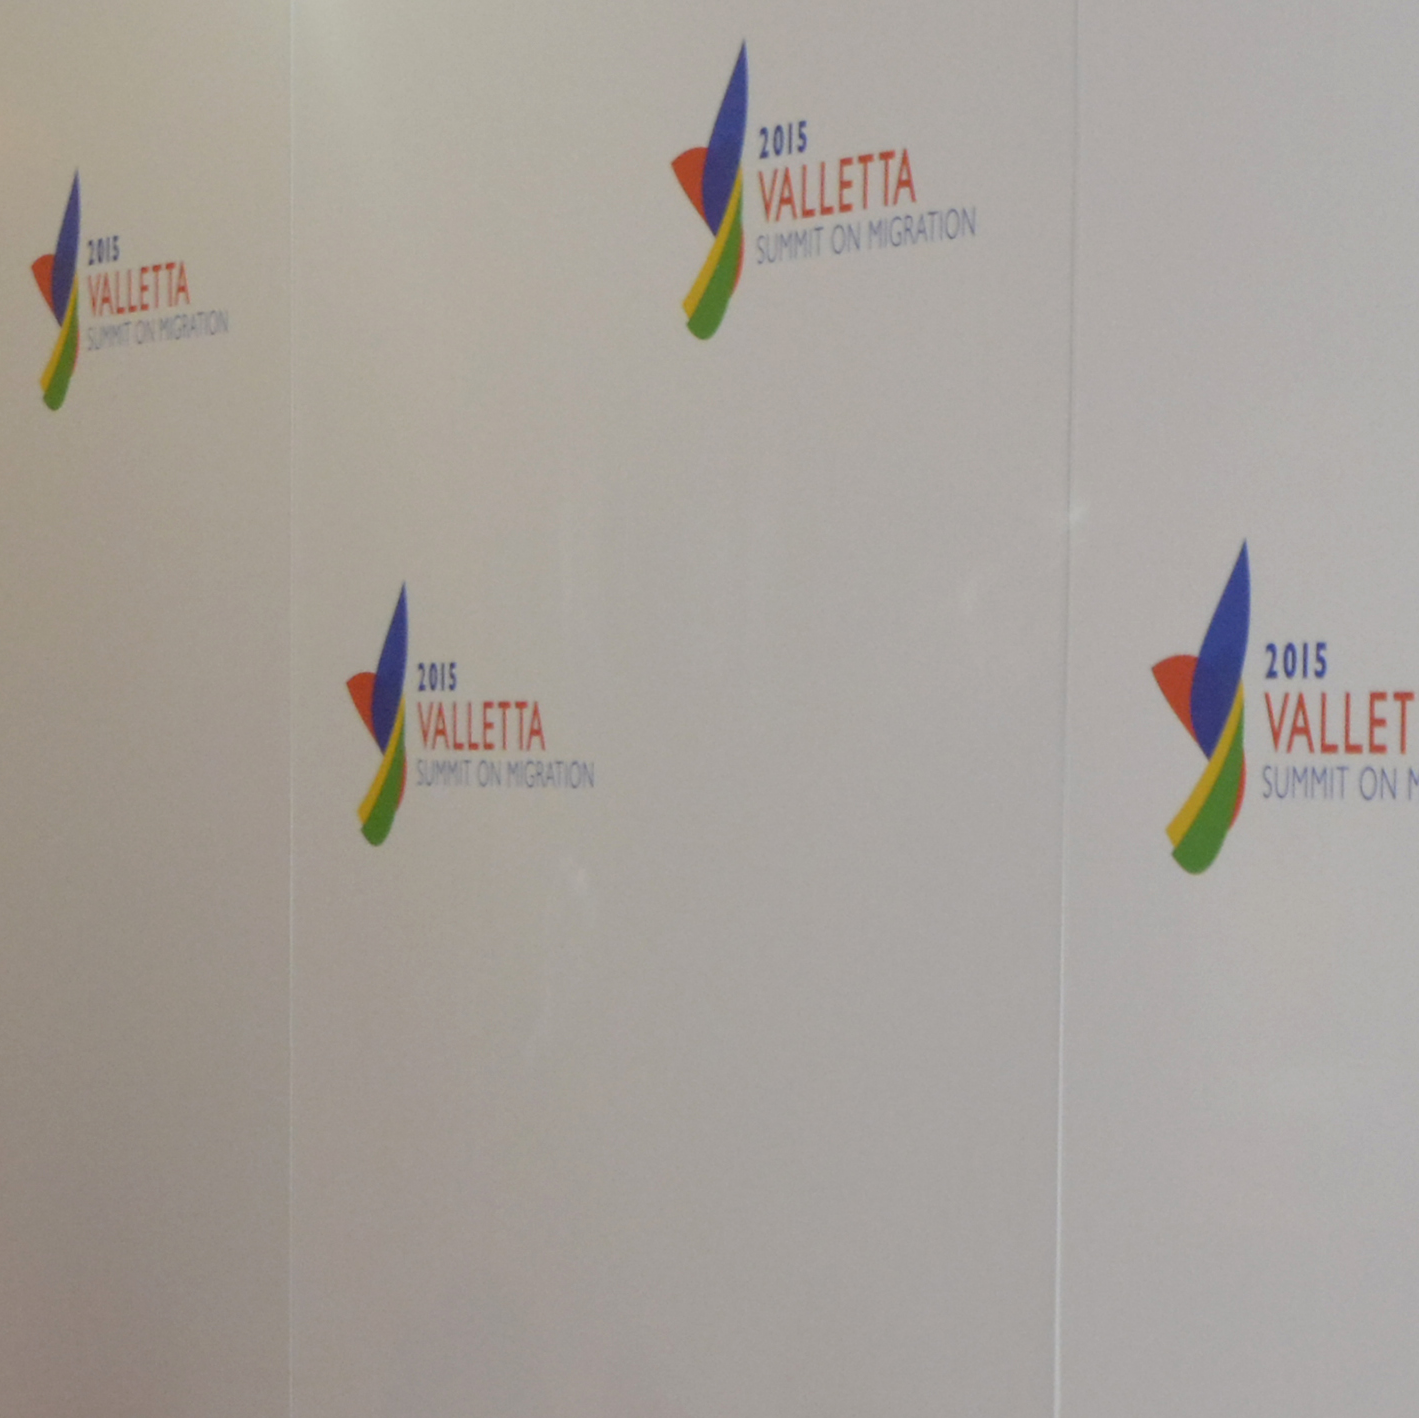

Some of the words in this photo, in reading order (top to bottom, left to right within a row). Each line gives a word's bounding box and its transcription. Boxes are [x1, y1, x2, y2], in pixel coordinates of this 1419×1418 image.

[758, 120, 808, 159] 2015
[758, 147, 917, 222] VALLETTA
[87, 235, 120, 266] 2015
[756, 225, 824, 265] SUMMIT
[830, 223, 861, 255] ON
[868, 206, 977, 251] MIGRATION
[87, 260, 191, 317] VALLETTA
[417, 662, 458, 692] 2015
[1264, 642, 1328, 679] 2015
[417, 701, 546, 751] VALLETTA
[416, 759, 471, 787] SUMMIT
[478, 760, 501, 788] ON
[508, 761, 595, 788] MIGRATION
[1262, 765, 1349, 800] SUMMIT
[1359, 765, 1398, 801] ON
